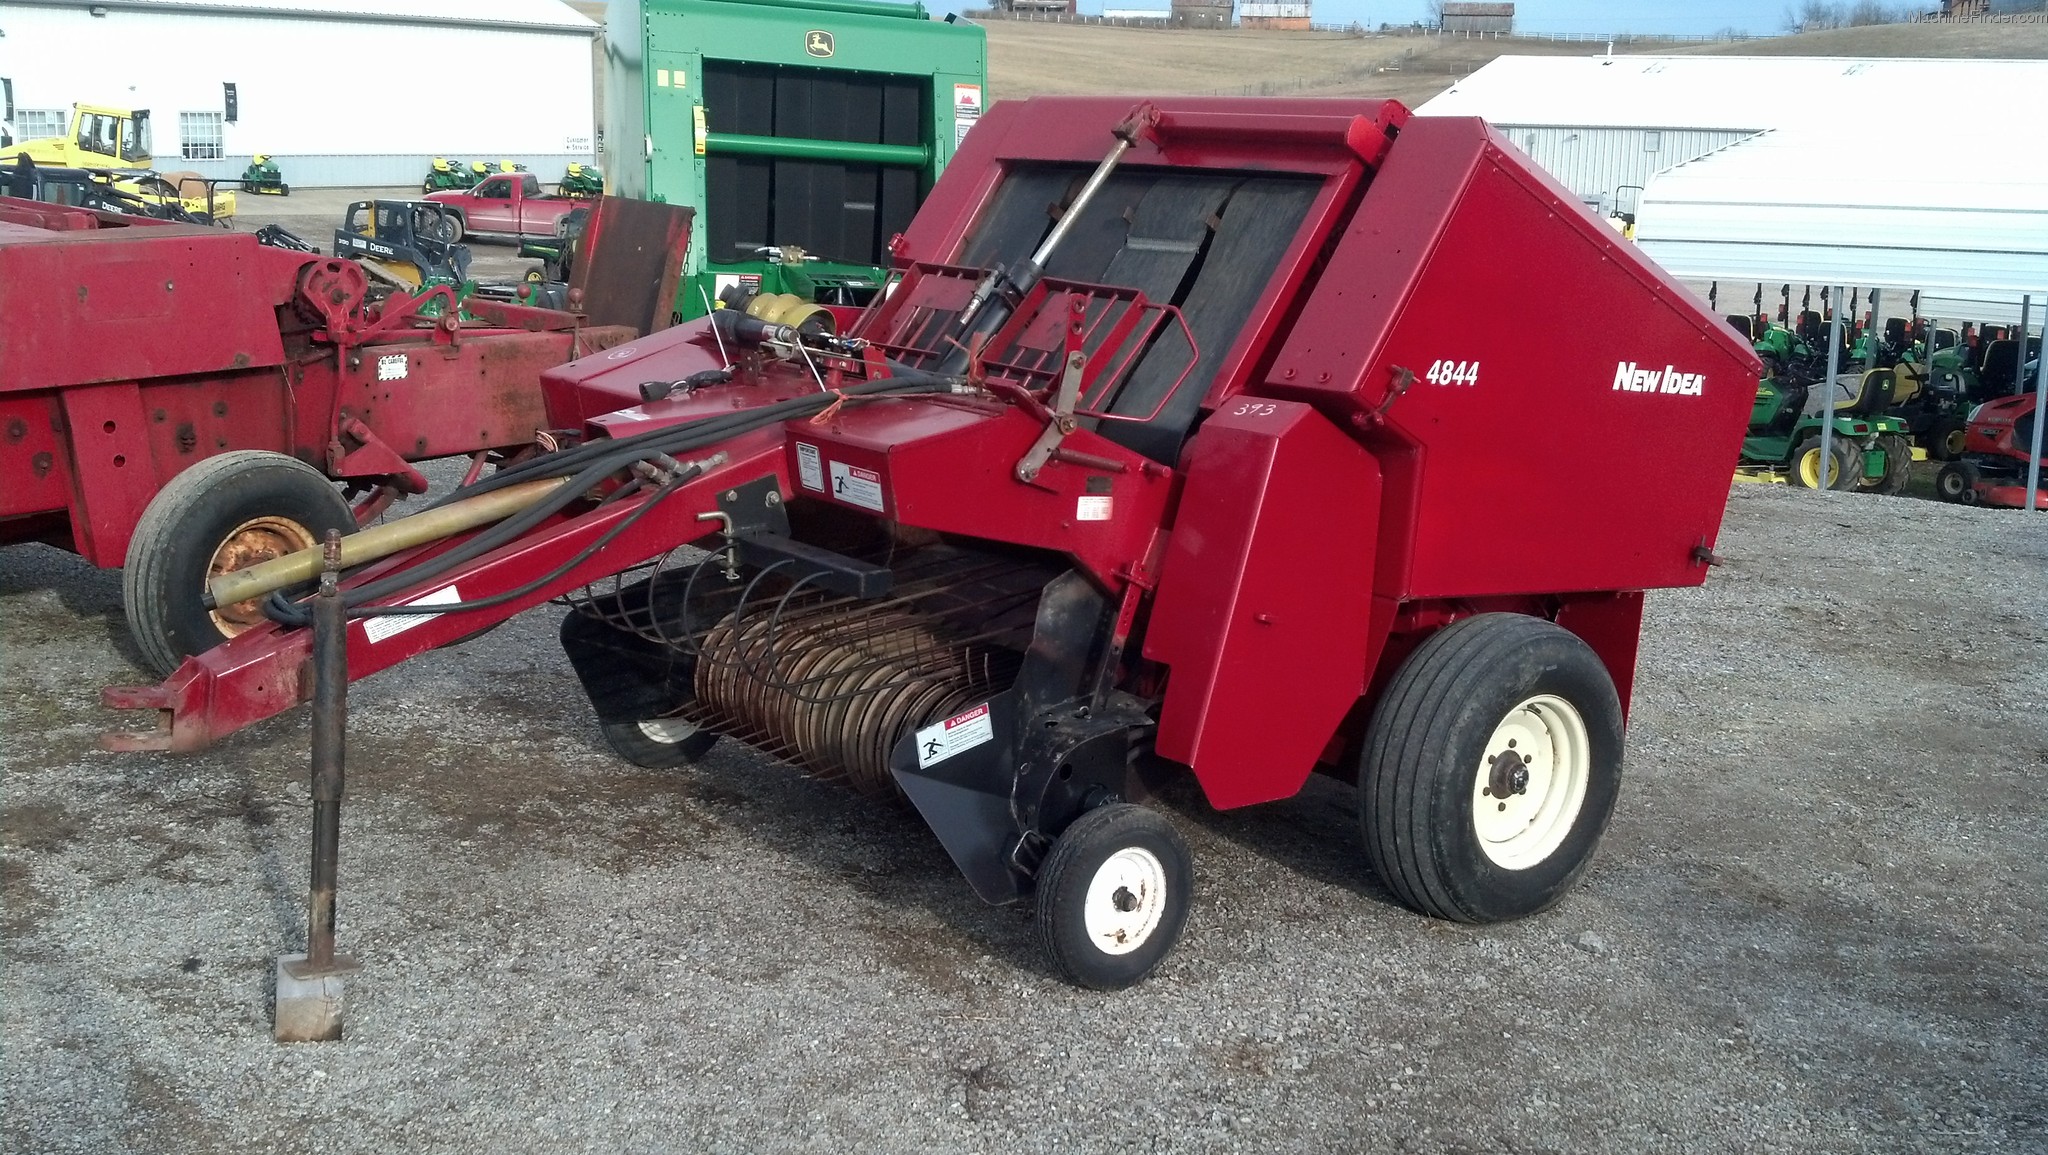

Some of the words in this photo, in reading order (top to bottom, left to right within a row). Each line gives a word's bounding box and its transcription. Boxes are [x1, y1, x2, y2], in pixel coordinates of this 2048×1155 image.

[369, 242, 394, 255] DEERE
[1425, 359, 1480, 386] 4844
[1233, 403, 1277, 416] 393
[956, 708, 984, 724] DANGER
